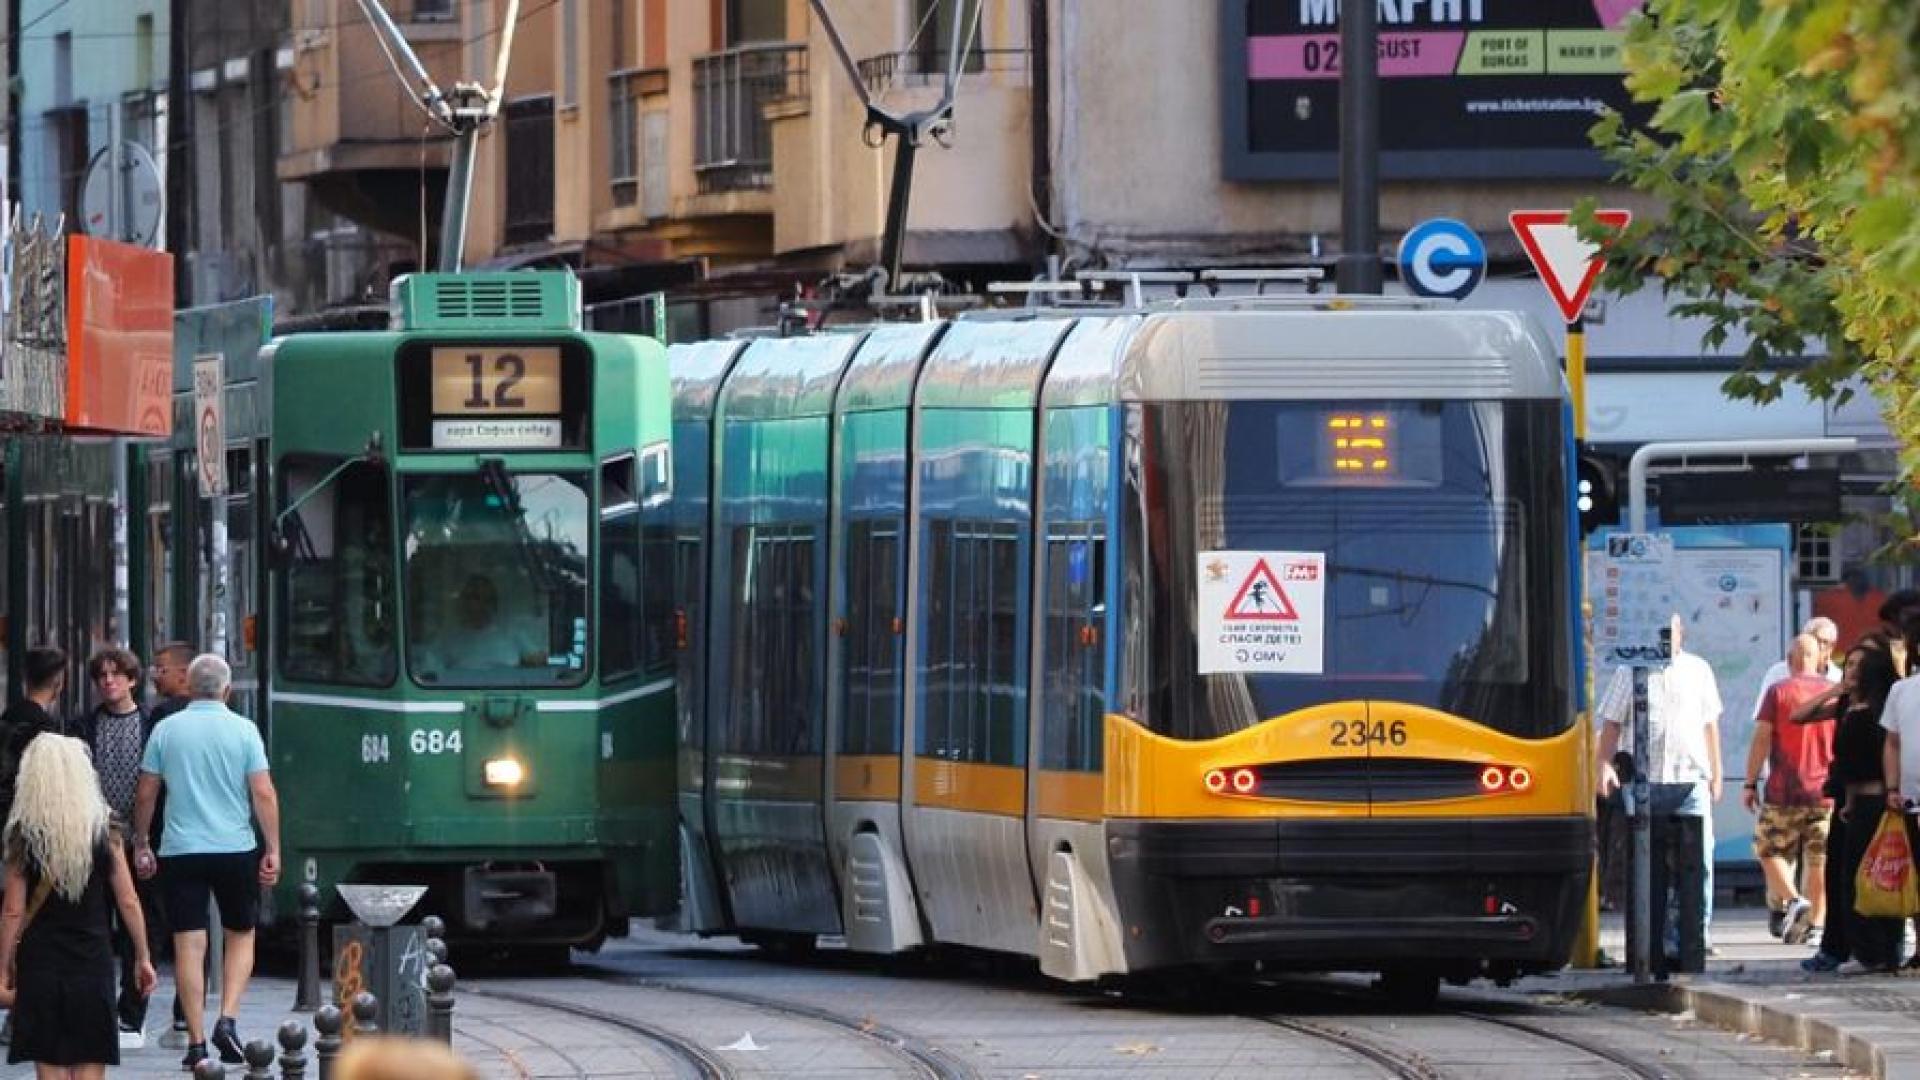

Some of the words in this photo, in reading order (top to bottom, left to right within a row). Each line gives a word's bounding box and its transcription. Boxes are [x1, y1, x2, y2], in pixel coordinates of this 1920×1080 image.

[1303, 40, 1339, 71] 02
[1480, 38, 1511, 50] PORT
[1514, 38, 1528, 50] OF
[1480, 54, 1528, 68] BURGAS
[464, 352, 525, 409] 12
[1219, 634, 1262, 644] СПАСИ
[1254, 651, 1286, 662] OMV
[410, 728, 463, 754] 684
[1330, 719, 1407, 747] 2346
[361, 734, 390, 763] 684
